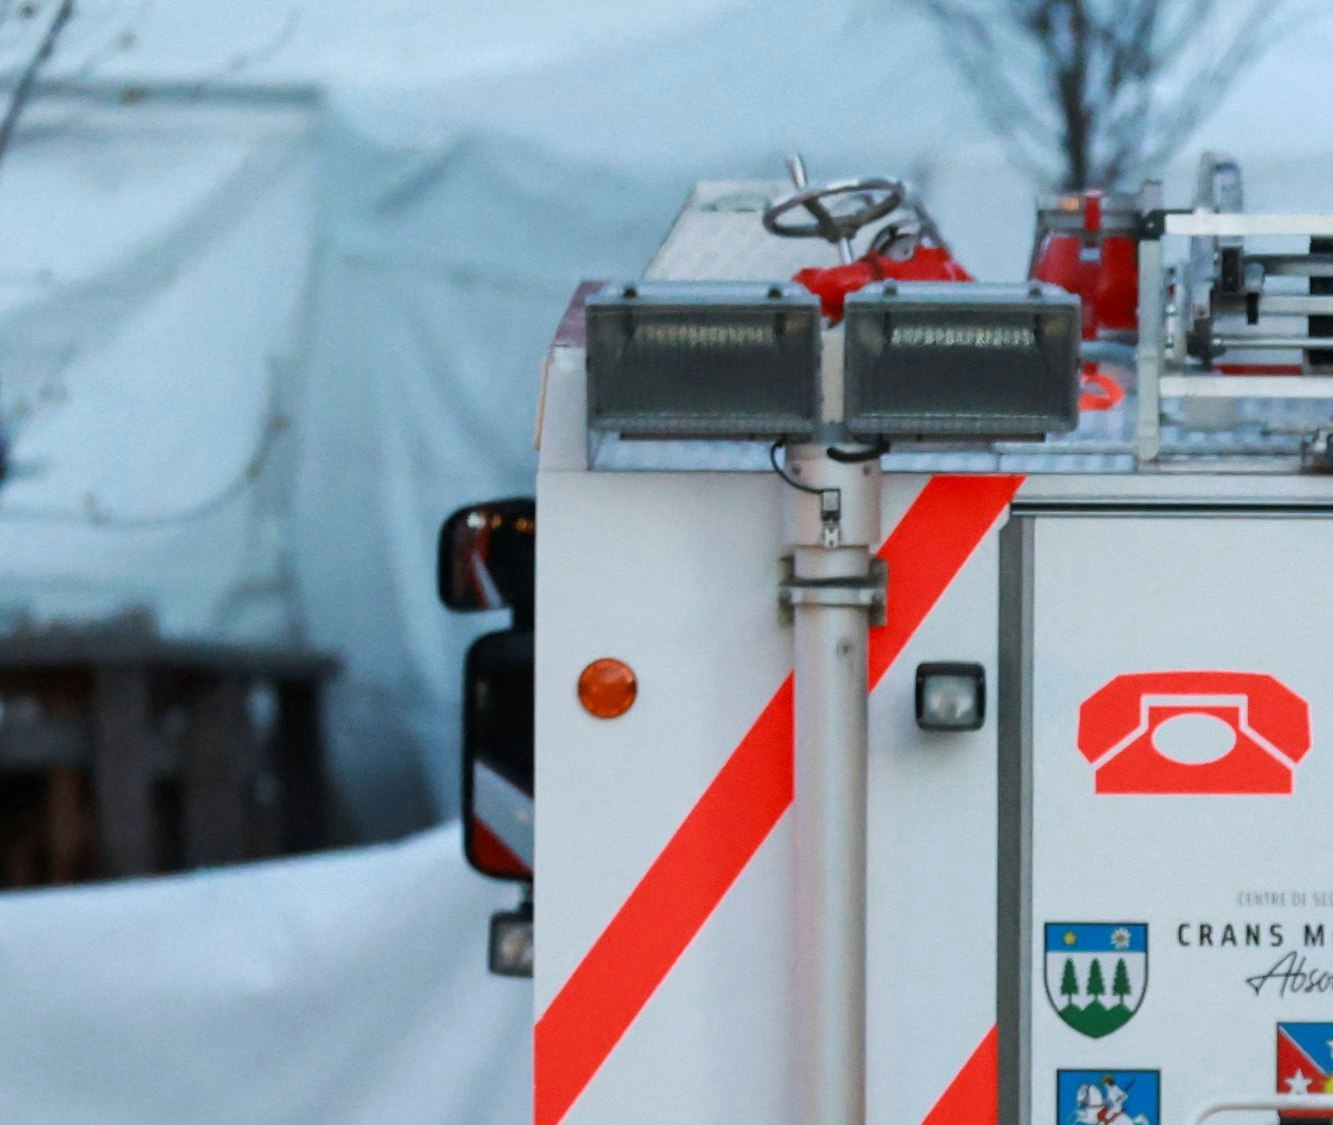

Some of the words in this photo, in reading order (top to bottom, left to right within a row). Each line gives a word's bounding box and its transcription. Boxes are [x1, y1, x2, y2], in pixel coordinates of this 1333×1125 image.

[1238, 891, 1286, 907] CENTRE
[1292, 891, 1307, 907] DE
[1177, 923, 1284, 947] CRANS
